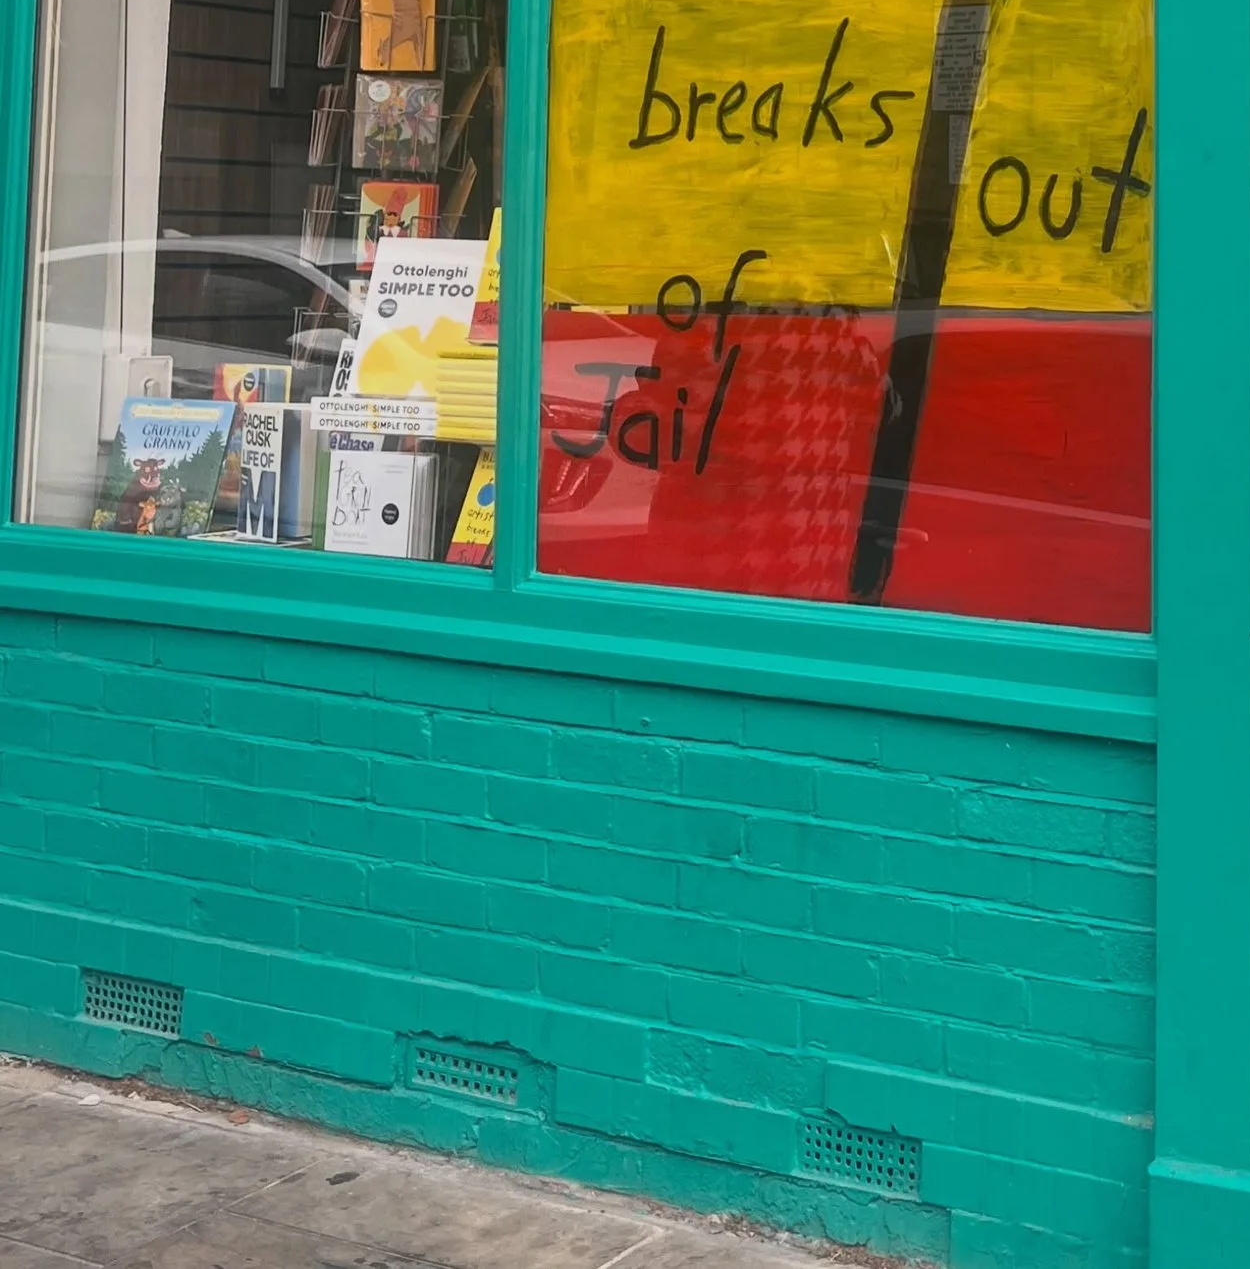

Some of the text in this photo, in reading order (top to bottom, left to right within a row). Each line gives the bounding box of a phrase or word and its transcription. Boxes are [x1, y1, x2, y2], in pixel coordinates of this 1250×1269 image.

[629, 17, 915, 149] breaks
[978, 108, 1151, 253] out
[392, 264, 468, 280] Ottolenghi
[378, 282, 434, 296] SIMPLE
[439, 284, 475, 297] TOO
[656, 249, 767, 362] of
[319, 402, 420, 415] OTTOLENGHI SIMPLE TOO
[551, 345, 741, 475] Jail
[143, 423, 200, 438] GRUFFALO
[243, 412, 278, 432] RACHEL
[319, 419, 420, 431] OTTOLENGHI SIMPLE TOO
[144, 436, 193, 451] GRANNY
[246, 431, 271, 447] CUSK
[243, 448, 274, 469] LIFE OF
[238, 466, 277, 539] M
